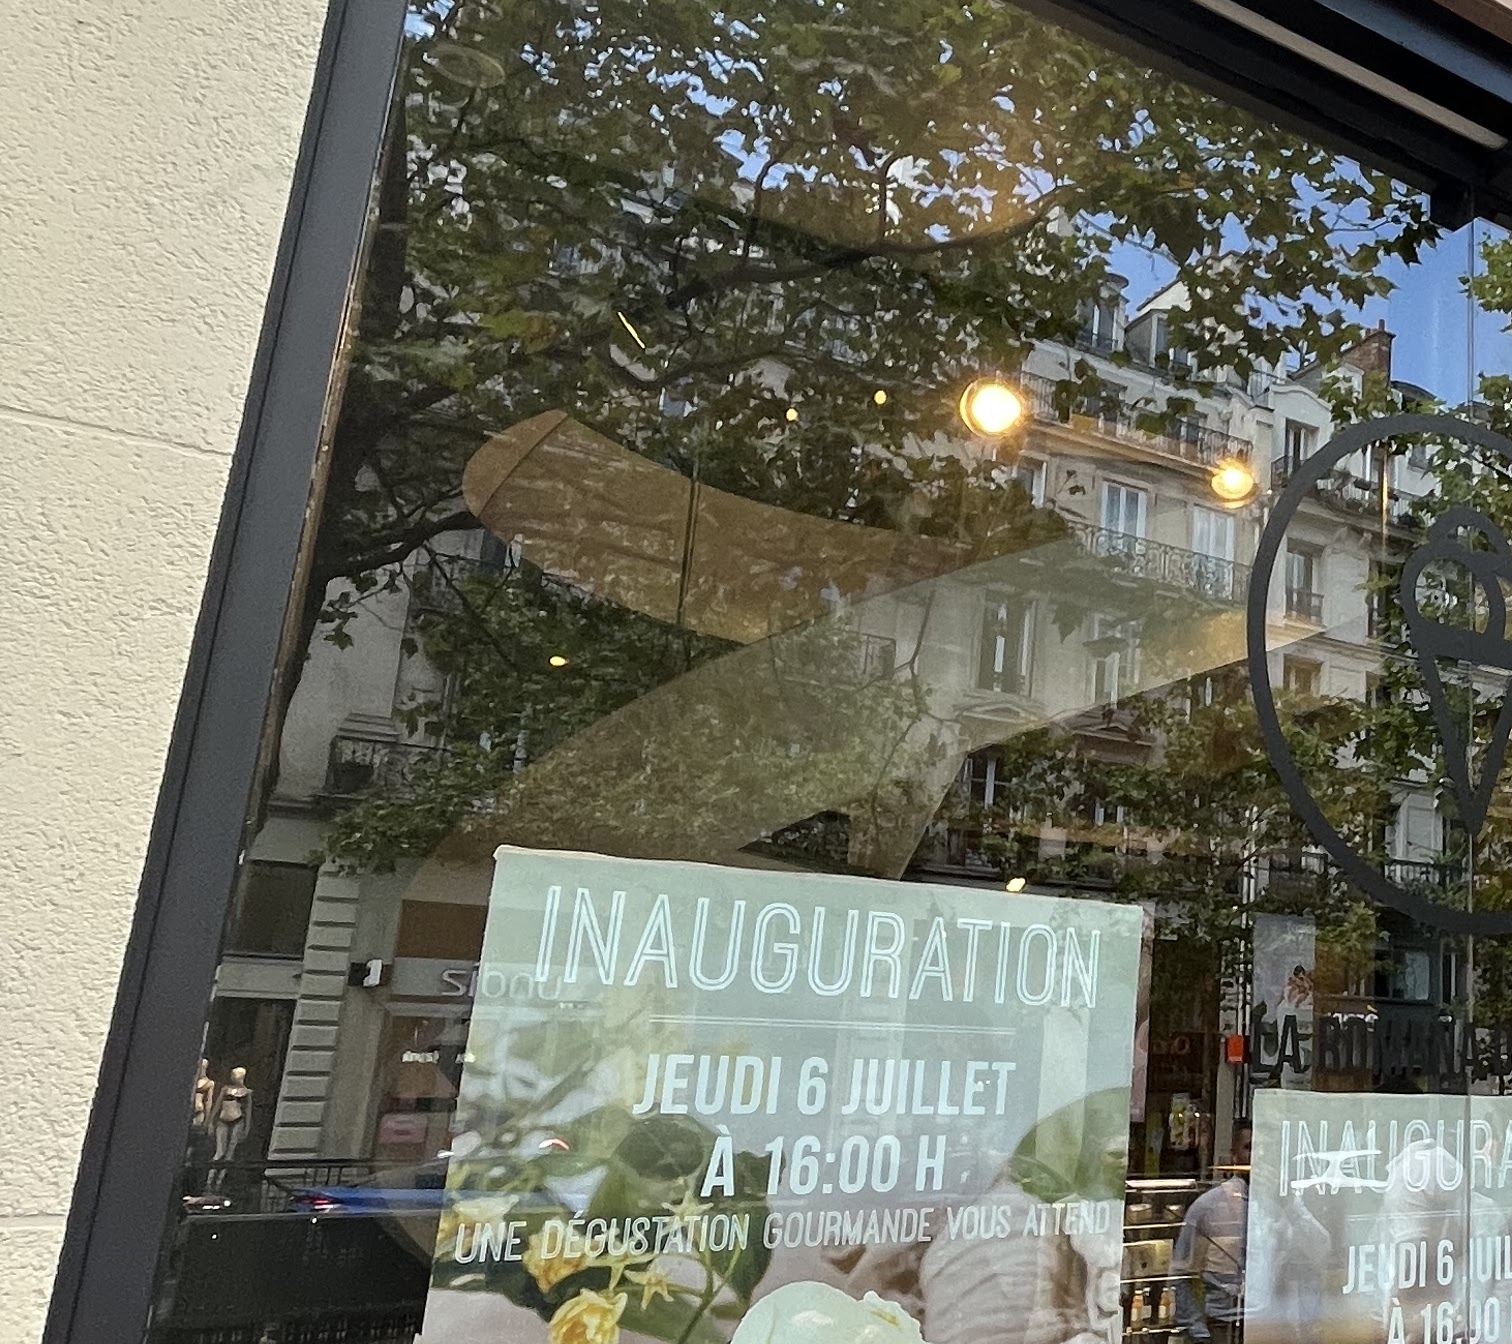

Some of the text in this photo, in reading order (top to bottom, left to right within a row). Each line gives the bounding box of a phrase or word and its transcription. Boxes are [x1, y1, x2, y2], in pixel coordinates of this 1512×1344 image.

[535, 885, 1101, 1009] INAUGURATION
[632, 1054, 1018, 1118] JEUDI 6 JUILLET
[700, 1123, 946, 1198] À 16:00 H
[454, 1200, 1111, 1265] UNE DÉGUSTATION GOURMANDE VOUS ATTEND
[1341, 1240, 1428, 1296] JEUDI
[1436, 1239, 1455, 1287] 6
